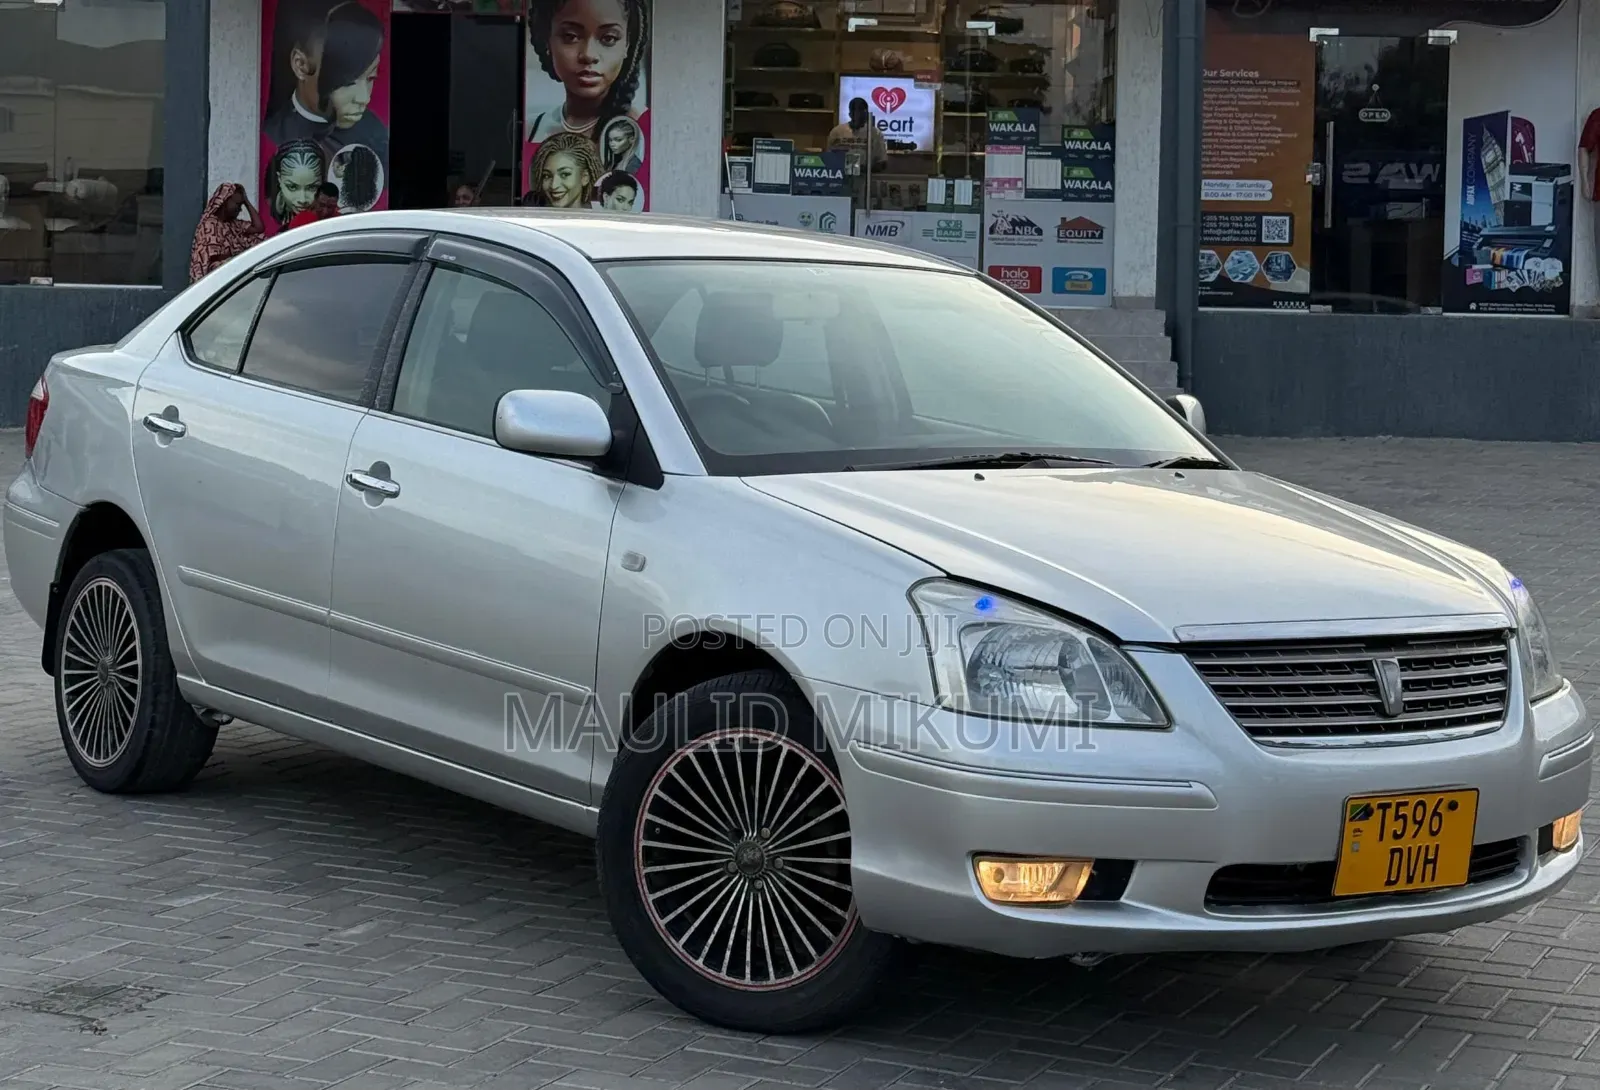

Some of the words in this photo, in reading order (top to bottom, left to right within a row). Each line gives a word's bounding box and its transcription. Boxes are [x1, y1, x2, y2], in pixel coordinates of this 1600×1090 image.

[1220, 69, 1260, 78] Services
[989, 123, 1036, 132] WAKALA
[1064, 140, 1112, 150] WAKALA
[1466, 133, 1477, 184] COMPANY
[794, 168, 844, 178] WAKALA
[1064, 180, 1112, 190] WAKALA
[865, 224, 898, 236] NMB
[1014, 226, 1038, 236] NBC
[1059, 230, 1101, 238] EQUITY
[1001, 267, 1028, 278] halo
[1376, 797, 1445, 842] T596
[1384, 843, 1440, 887] DVH
